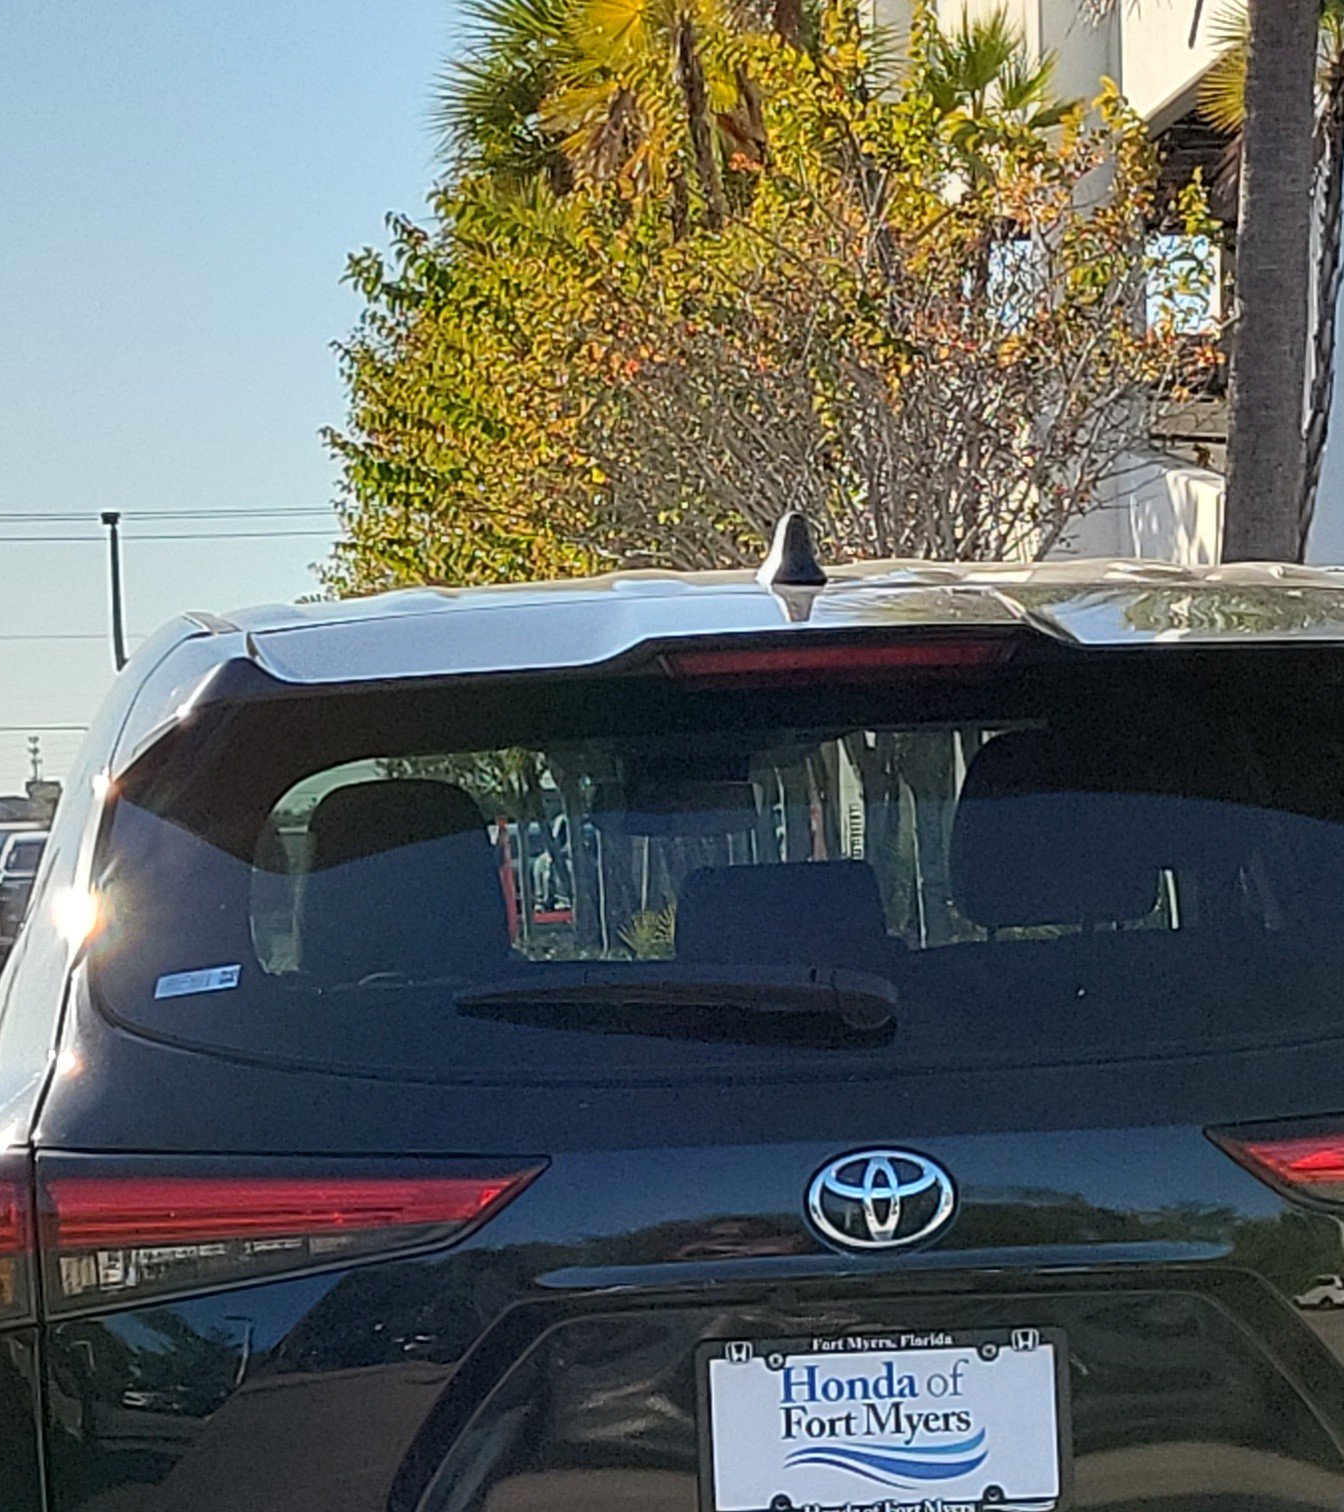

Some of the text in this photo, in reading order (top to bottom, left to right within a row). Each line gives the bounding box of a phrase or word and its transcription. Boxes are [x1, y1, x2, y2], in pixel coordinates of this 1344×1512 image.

[812, 1337, 844, 1351] Fort
[900, 1332, 954, 1347] Florida
[779, 1358, 970, 1404] Honda of
[779, 1401, 972, 1446] Fort Myers
